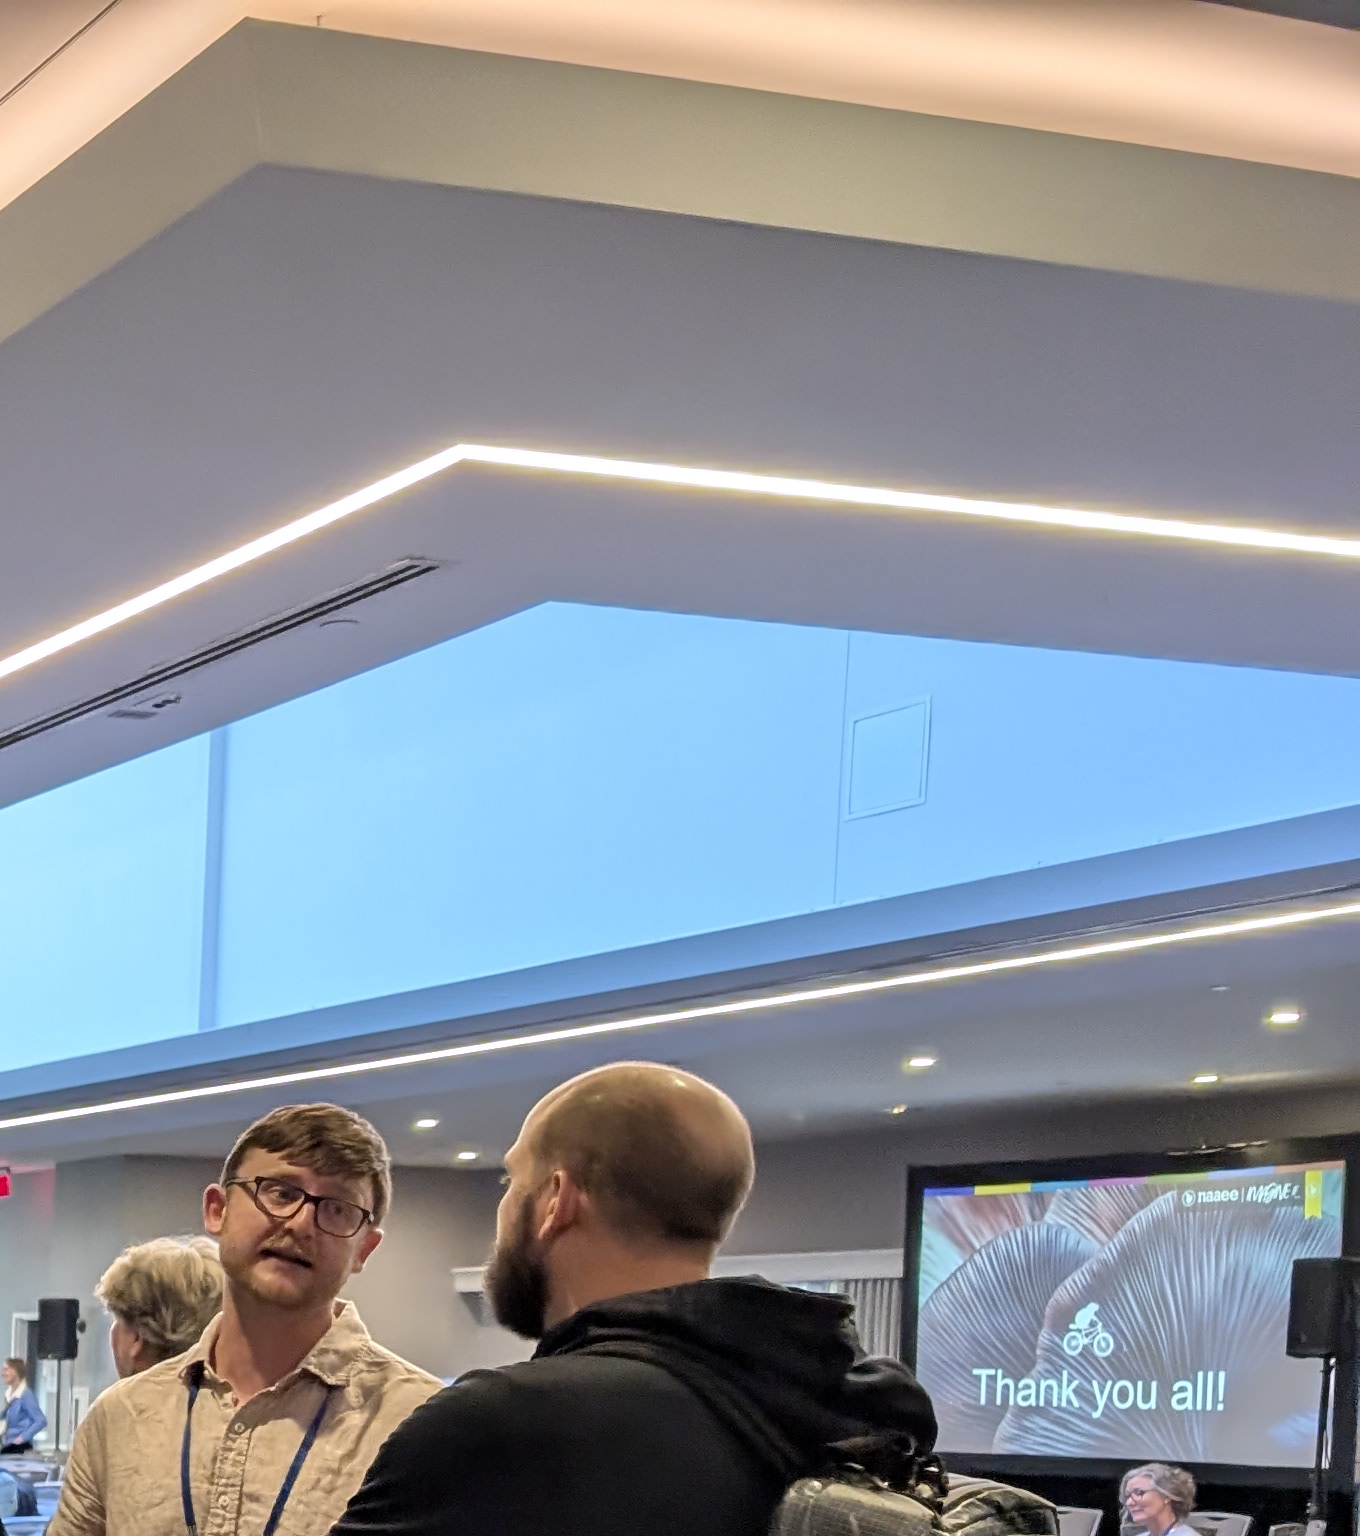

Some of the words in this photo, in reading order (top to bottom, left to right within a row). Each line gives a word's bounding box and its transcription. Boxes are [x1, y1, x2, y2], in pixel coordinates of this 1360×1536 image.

[1197, 1189, 1239, 1203] naaee
[973, 1369, 1079, 1408] Thank
[1091, 1378, 1157, 1418] you
[1171, 1370, 1225, 1411] all!
